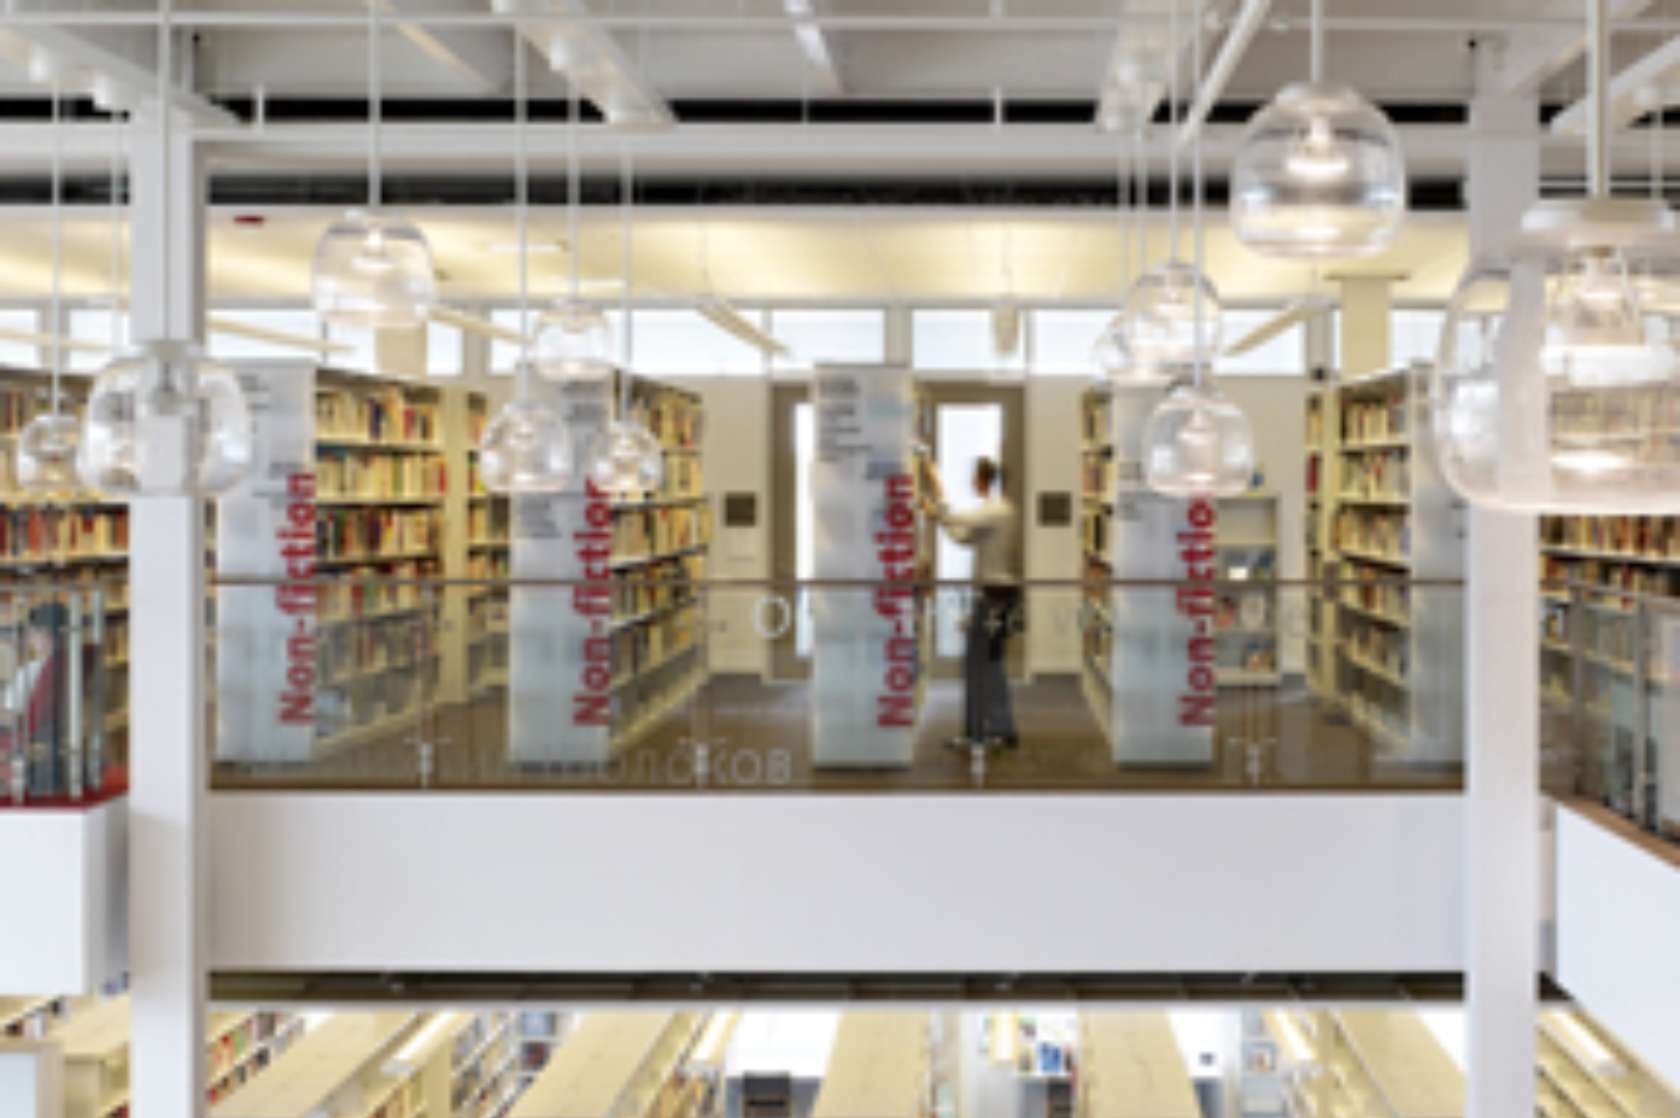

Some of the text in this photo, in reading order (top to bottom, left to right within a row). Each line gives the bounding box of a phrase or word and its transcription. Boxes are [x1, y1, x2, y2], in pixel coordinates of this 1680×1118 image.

[276, 472, 316, 725] Non-fiction
[873, 474, 914, 727] Non-fiction
[1175, 496, 1216, 726] Non-fictio
